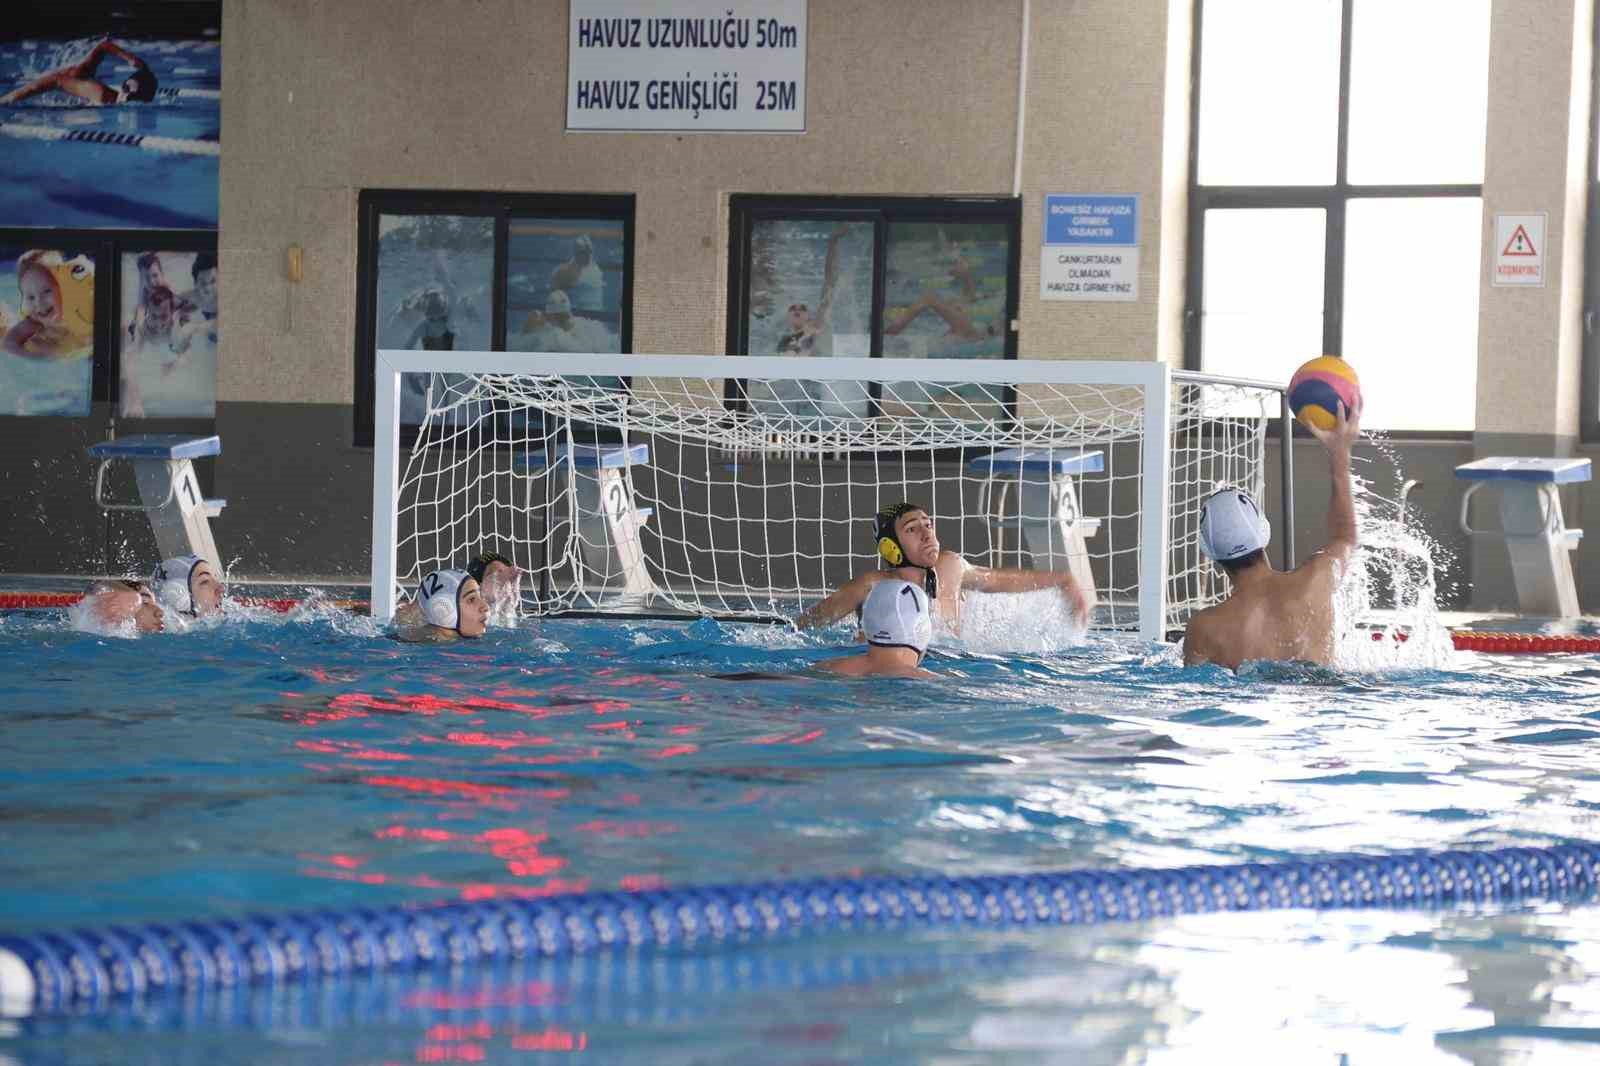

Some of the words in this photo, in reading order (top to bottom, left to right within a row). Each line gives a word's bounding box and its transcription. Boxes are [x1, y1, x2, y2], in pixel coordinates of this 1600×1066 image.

[578, 18, 642, 48] HAVUZ
[647, 8, 750, 48] UZUNLUĞU
[756, 18, 797, 49] 50m
[576, 80, 640, 110] HAVUZ
[646, 71, 738, 119] GENİŞLİĞİ
[755, 80, 796, 110] 25M
[1058, 255, 1122, 264] CANKURTARAN
[1068, 269, 1112, 279] OLMADAN
[182, 474, 196, 506] 1
[610, 484, 627, 522] 2
[1062, 491, 1075, 527] 3
[417, 572, 444, 600] 12
